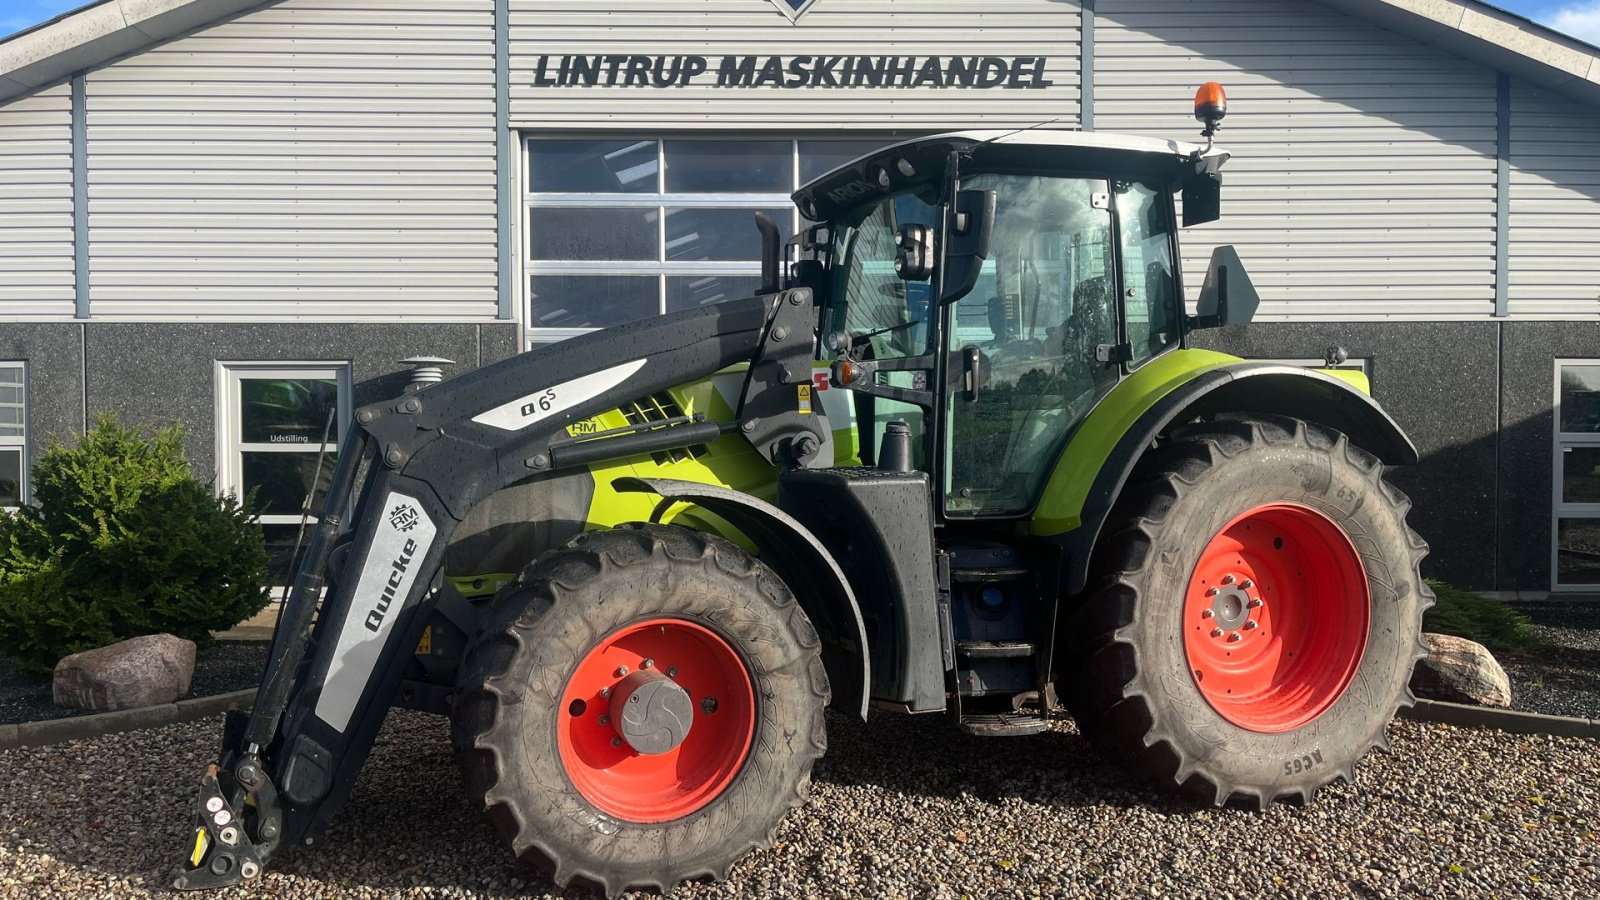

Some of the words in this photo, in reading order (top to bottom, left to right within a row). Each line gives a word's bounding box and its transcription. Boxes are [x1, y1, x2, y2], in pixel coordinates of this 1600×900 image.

[533, 55, 708, 87] LINTRUP
[718, 56, 1053, 88] MASKINHANDEL
[827, 179, 877, 204] ARION
[270, 434, 309, 444] Udstilling
[571, 422, 597, 433] RM
[389, 506, 419, 530] RM
[364, 537, 418, 633] Quicke
[1284, 748, 1324, 776] AC65
